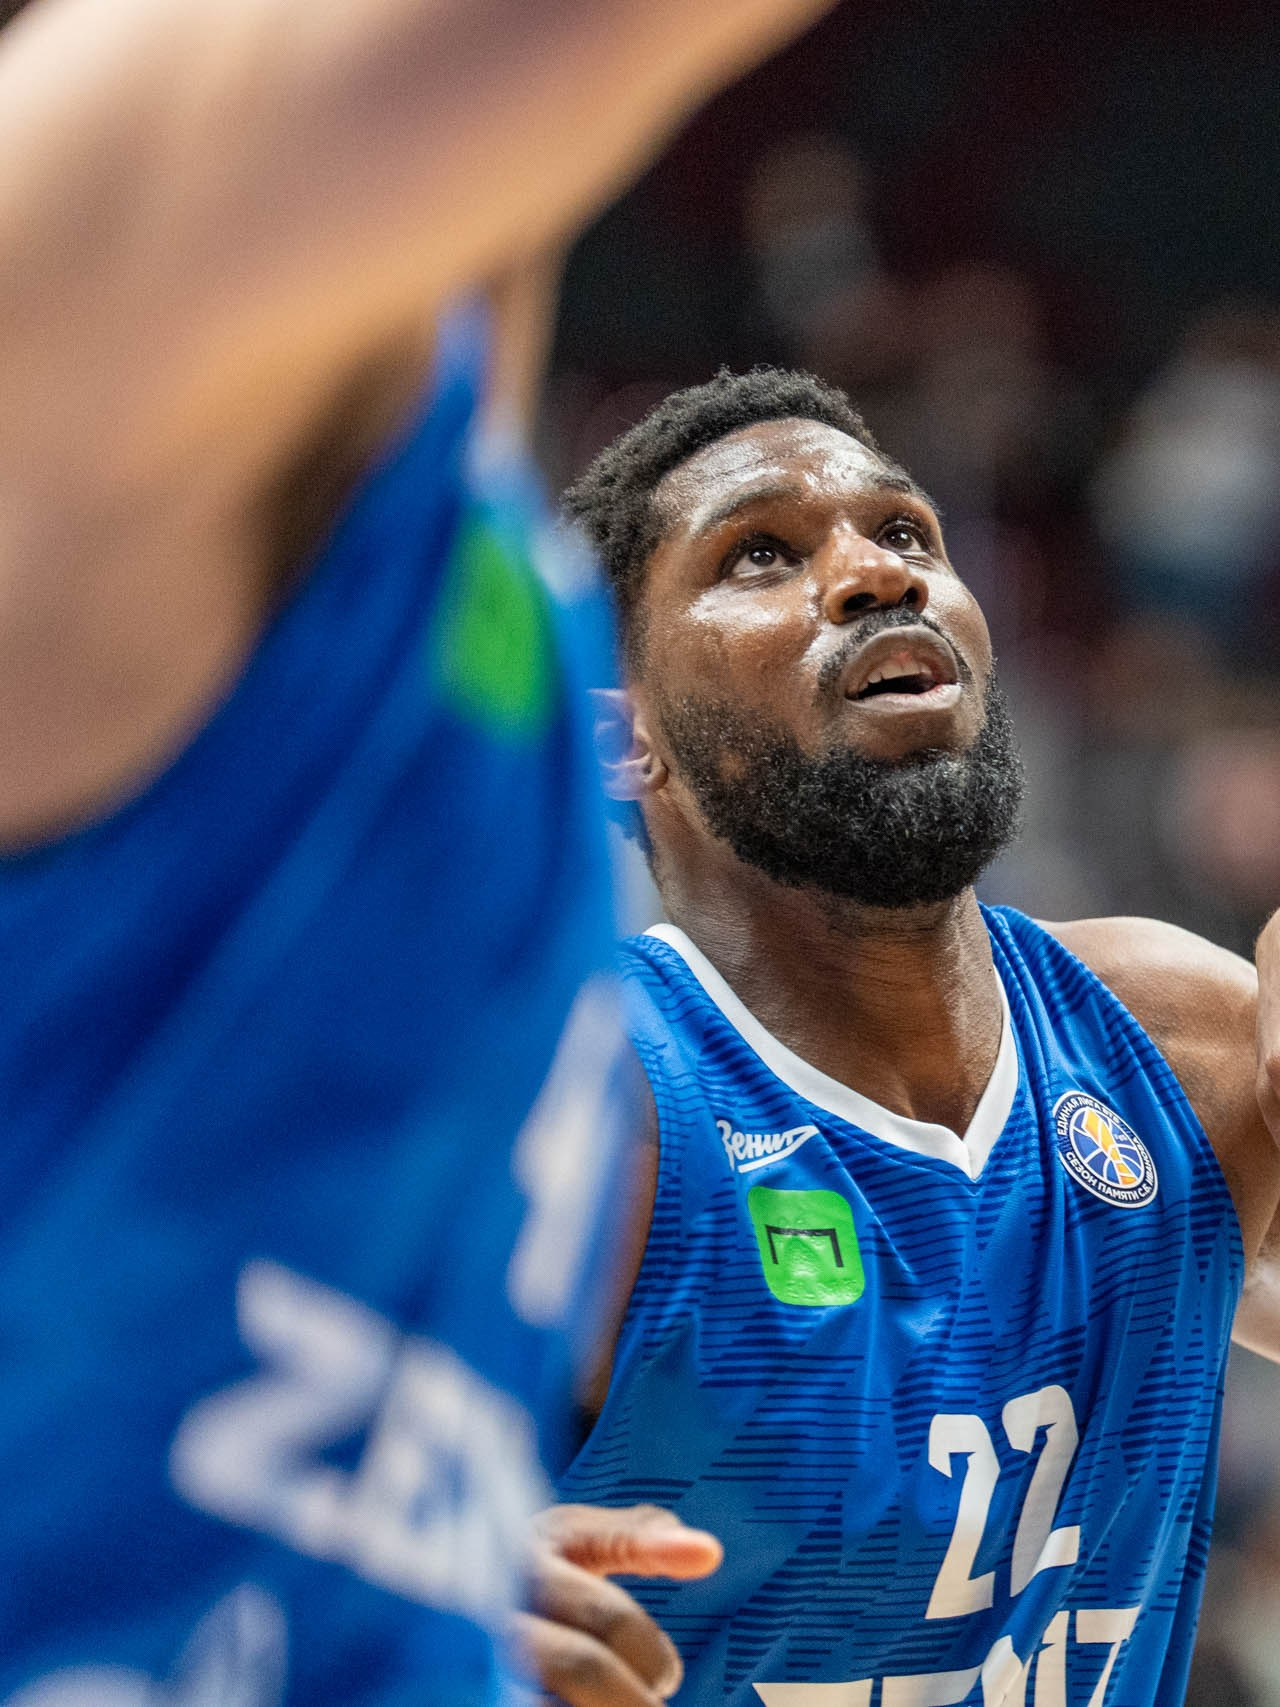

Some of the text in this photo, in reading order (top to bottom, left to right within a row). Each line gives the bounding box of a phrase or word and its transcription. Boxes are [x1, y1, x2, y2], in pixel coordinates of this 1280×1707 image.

[1057, 1098, 1080, 1136] ЕДИНАЯ
[1065, 1151, 1098, 1187] СЕЗОН
[1097, 1182, 1138, 1200] ПАМЯТИ
[925, 1384, 1080, 1619] 22
